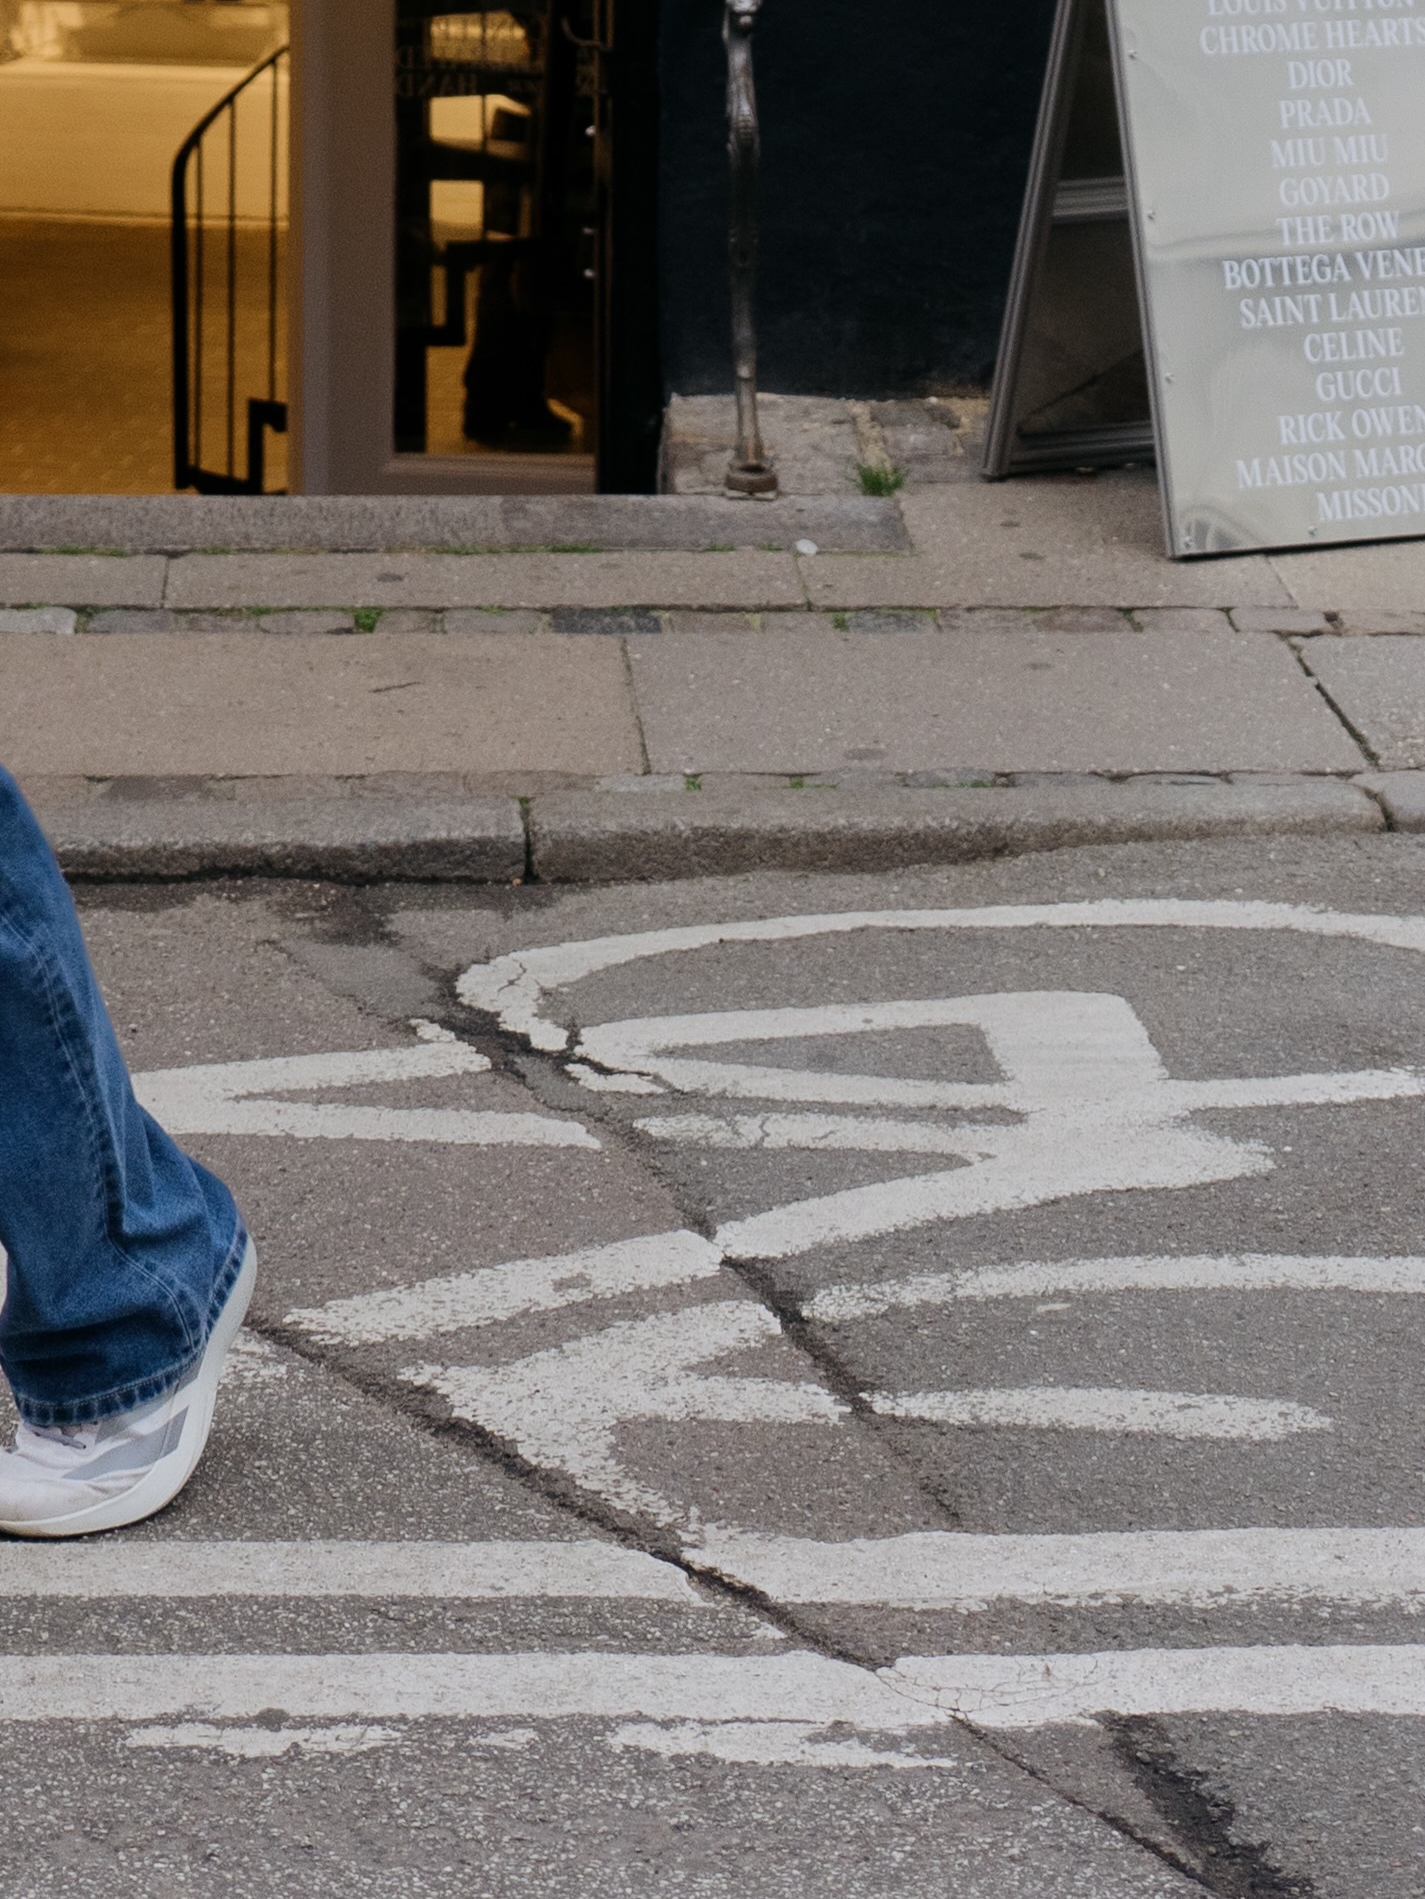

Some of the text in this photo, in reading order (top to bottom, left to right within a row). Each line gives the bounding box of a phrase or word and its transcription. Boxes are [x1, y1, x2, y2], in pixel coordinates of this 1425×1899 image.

[1200, 21, 1320, 56] CHROME
[1287, 59, 1355, 90] DIOR
[1278, 97, 1373, 129] PRADA
[1270, 133, 1389, 168] MIU MIU
[1279, 173, 1391, 206] GOYARD
[1276, 210, 1401, 246] THE ROW
[1222, 253, 1352, 290] BOTTEGA
[1240, 294, 1322, 329] SAINT
[1304, 327, 1405, 363] CELINE
[1316, 366, 1403, 401] GUCCI
[1278, 411, 1346, 445] RICK
[1236, 452, 1347, 489] MAISON
